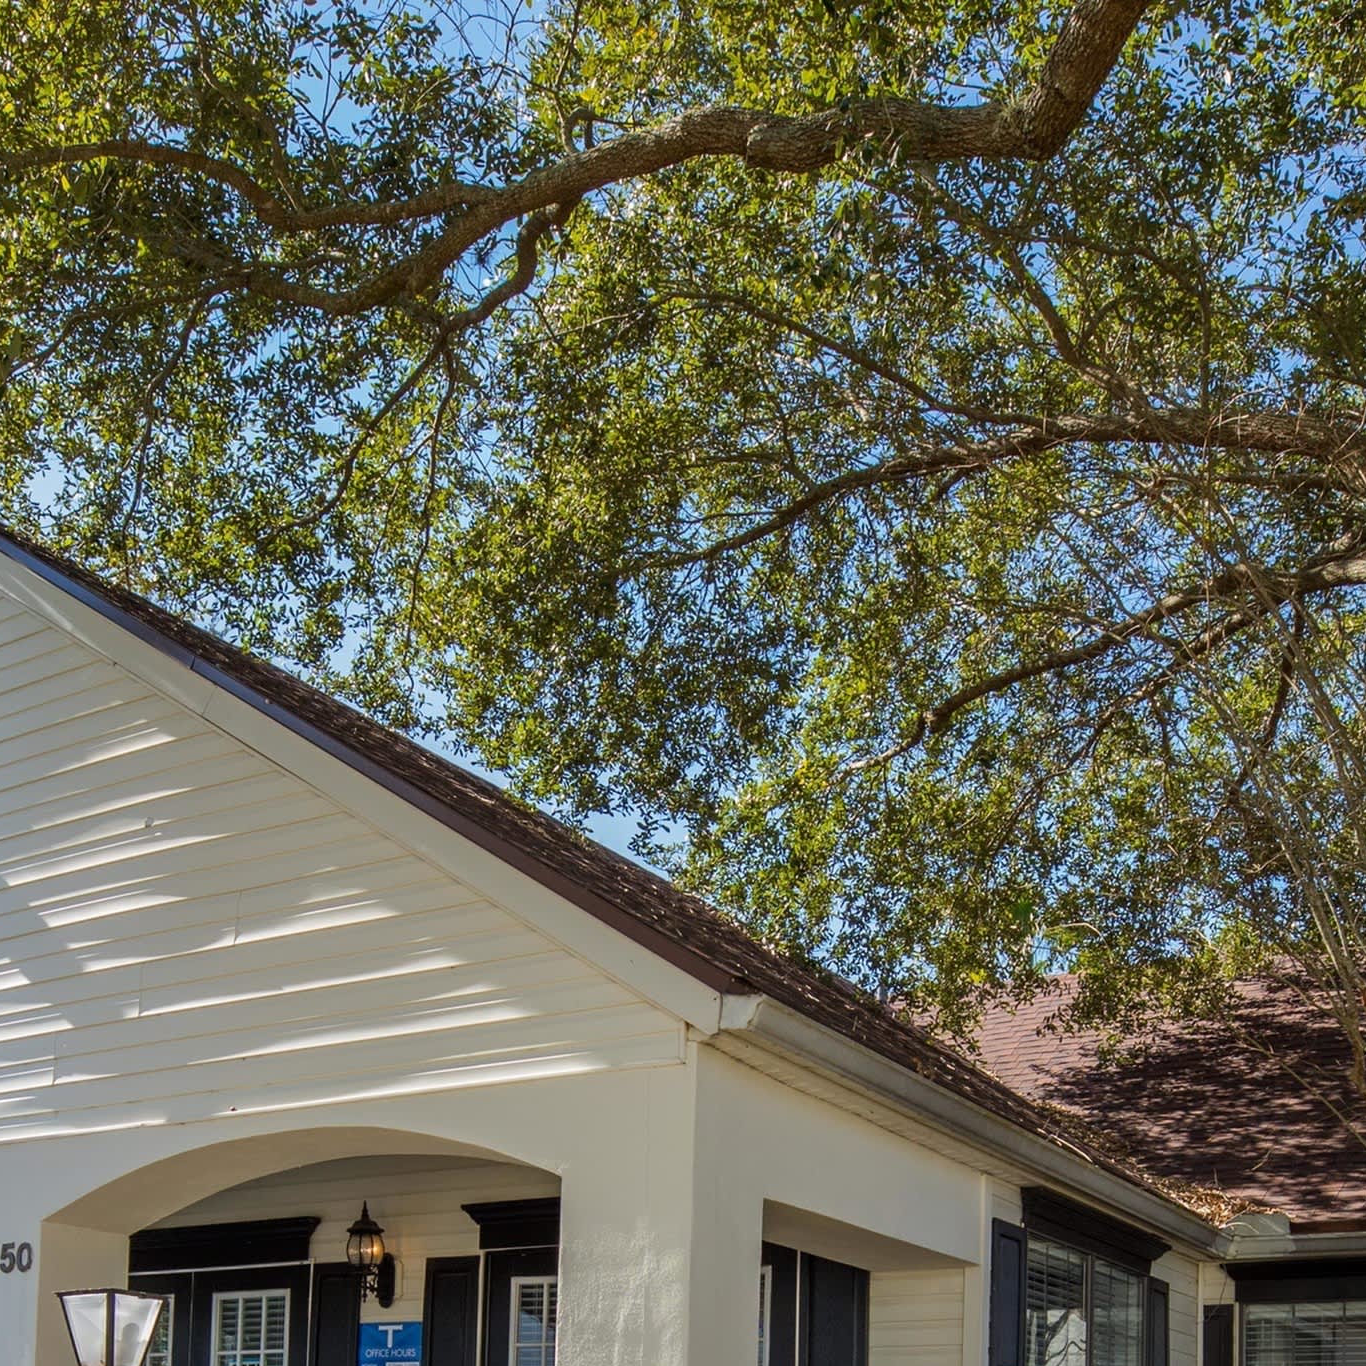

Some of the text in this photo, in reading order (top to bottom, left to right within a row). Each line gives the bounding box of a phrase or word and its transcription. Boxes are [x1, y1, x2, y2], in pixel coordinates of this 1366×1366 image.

[378, 1324, 403, 1348] T
[365, 1348, 416, 1358] OFFICE HOURS
